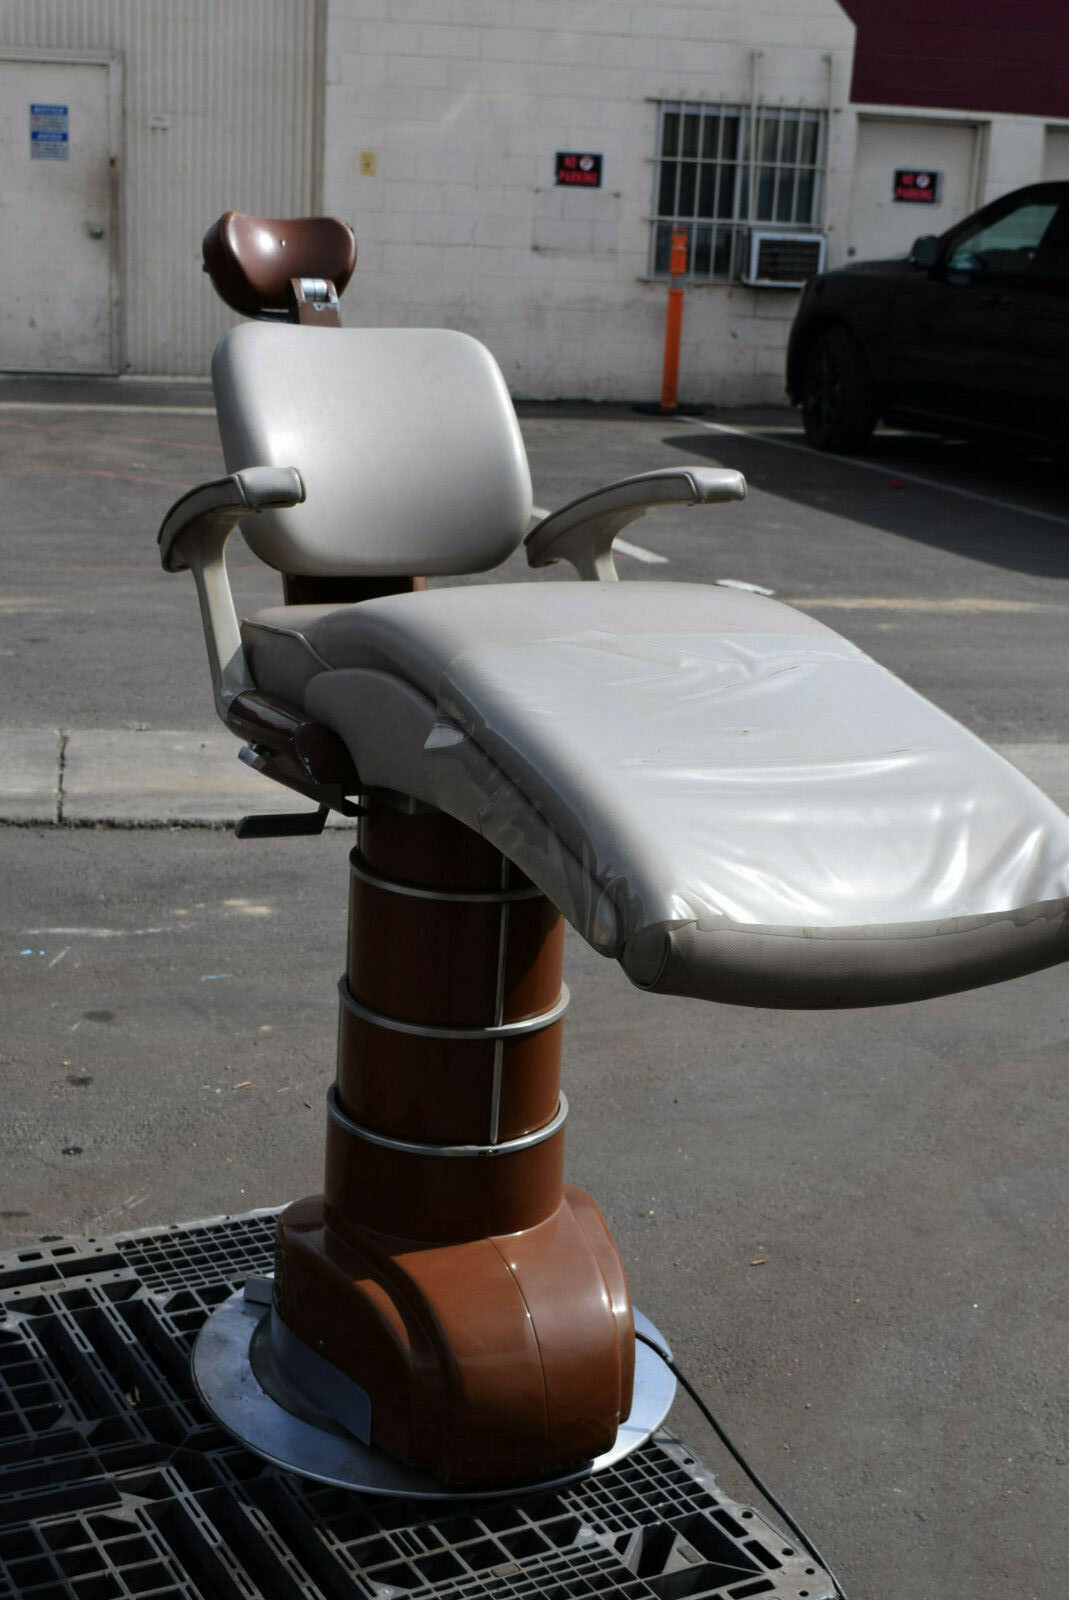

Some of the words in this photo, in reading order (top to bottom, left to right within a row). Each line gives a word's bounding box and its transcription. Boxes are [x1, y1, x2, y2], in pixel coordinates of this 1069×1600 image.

[563, 155, 577, 169] NO
[558, 170, 598, 185] PARKING
[901, 173, 914, 185] NO
[896, 187, 933, 201] PARKING
